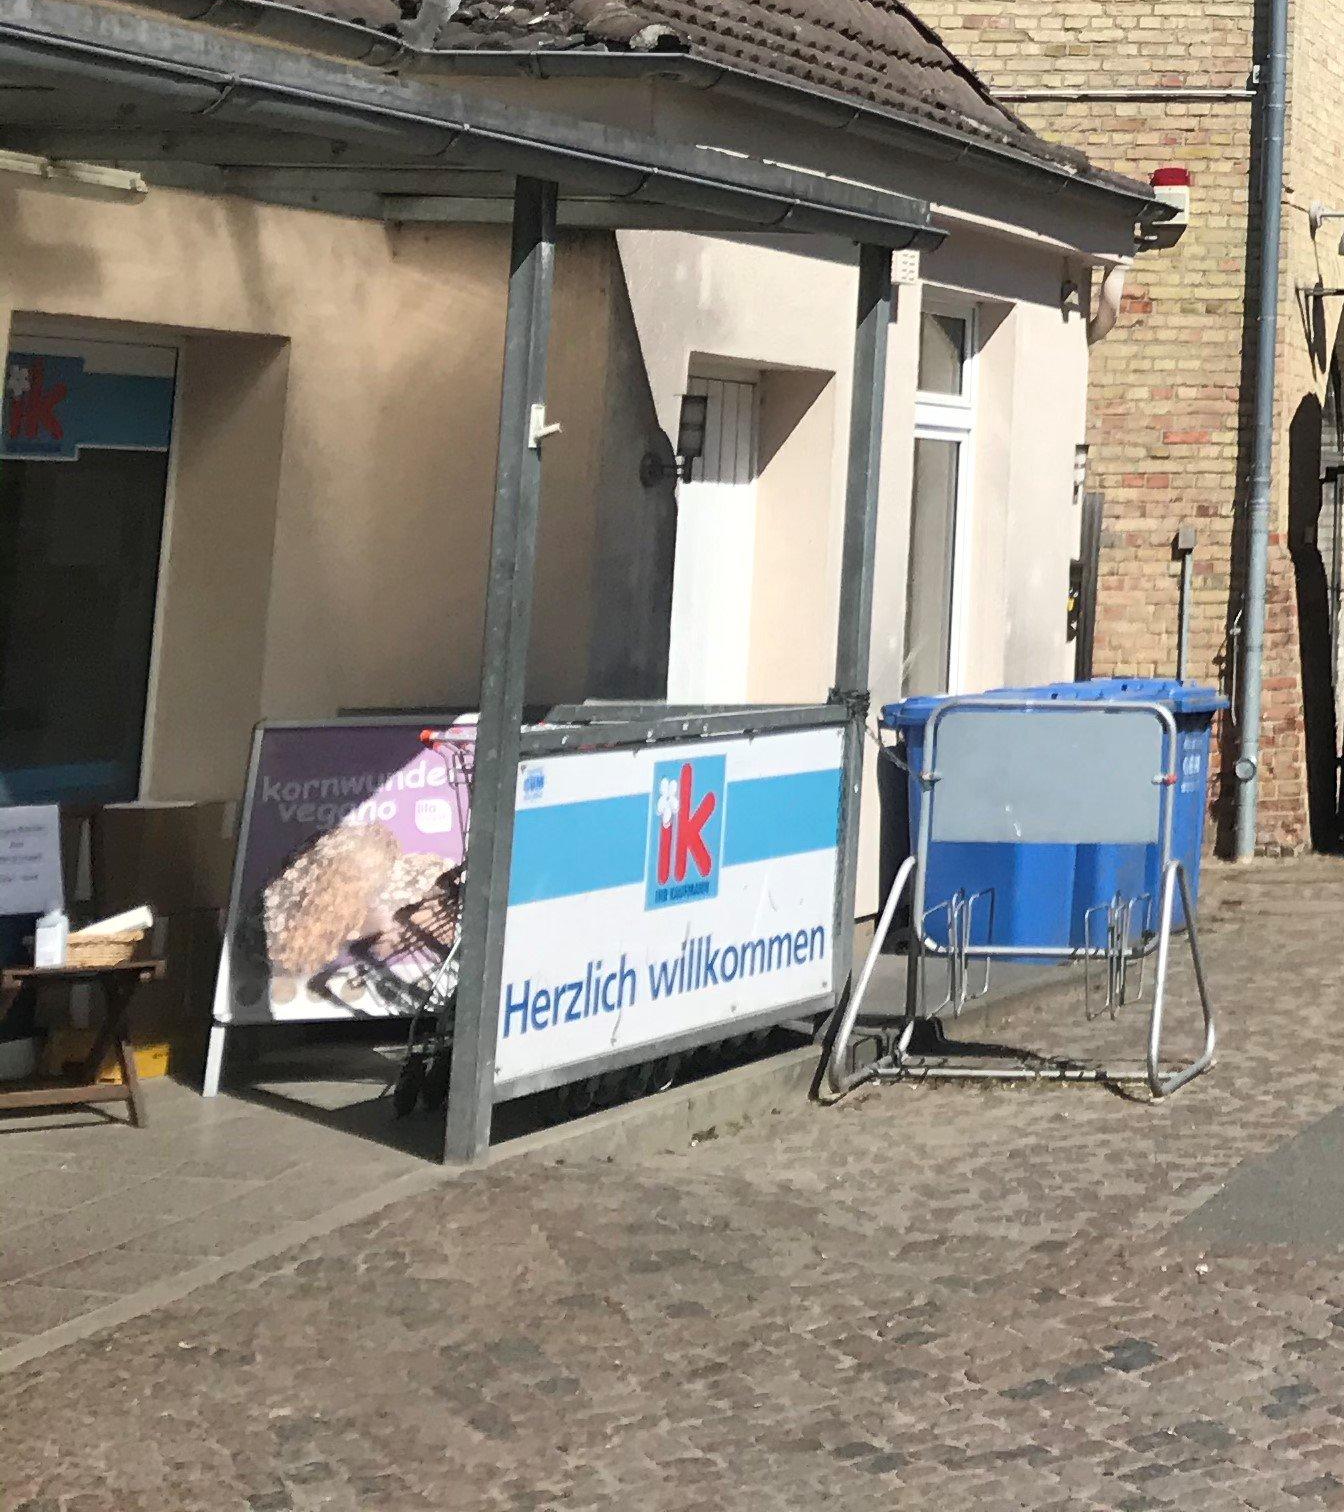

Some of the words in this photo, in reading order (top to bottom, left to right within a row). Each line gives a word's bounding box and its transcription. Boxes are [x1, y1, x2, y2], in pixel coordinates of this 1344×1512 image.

[278, 799, 397, 833] vegano
[503, 953, 637, 1039] Herzlich
[649, 925, 826, 1002] willkommen
